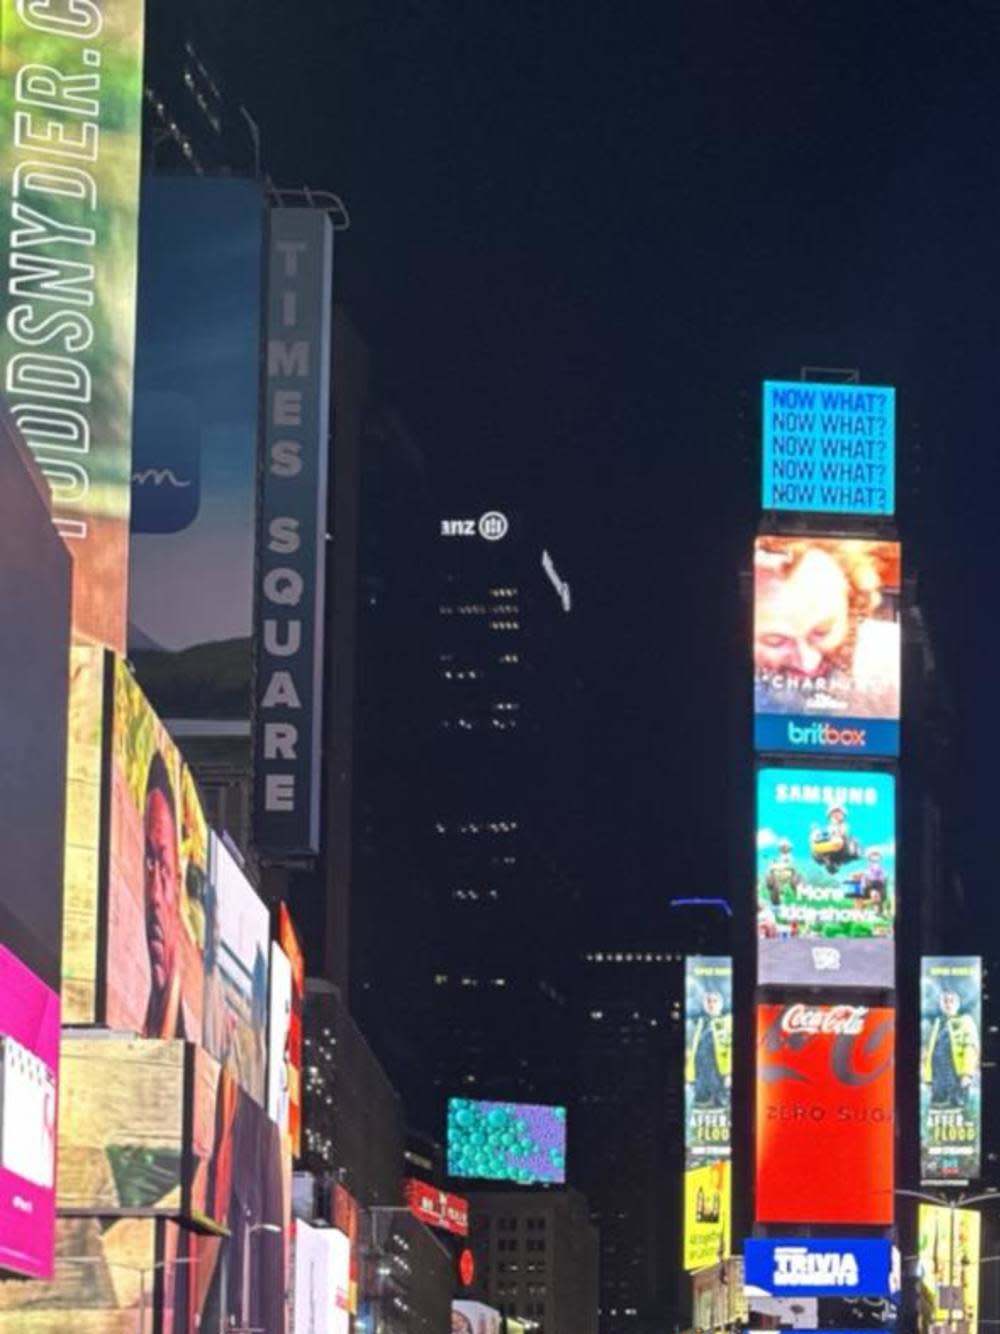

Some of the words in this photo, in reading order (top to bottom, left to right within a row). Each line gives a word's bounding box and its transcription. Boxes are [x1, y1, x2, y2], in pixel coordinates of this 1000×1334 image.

[267, 241, 310, 478] TIMES
[772, 389, 816, 409] NOW
[820, 390, 888, 413] WHAT?
[772, 412, 816, 432] NOW
[820, 413, 888, 437] WHAT?
[772, 436, 816, 456] NOW
[820, 437, 888, 461] WHAT?
[772, 460, 816, 480] NOW
[820, 461, 888, 485] WHAT?
[772, 484, 816, 504] NOW
[820, 485, 888, 510] WHAT?
[262, 516, 304, 812] SQUARE
[787, 721, 866, 747] britbox
[775, 782, 877, 806] SAMSUNG
[781, 1003, 869, 1036] Coca-Cola
[766, 1103, 826, 1122] ZERO
[836, 1105, 891, 1122] SUG
